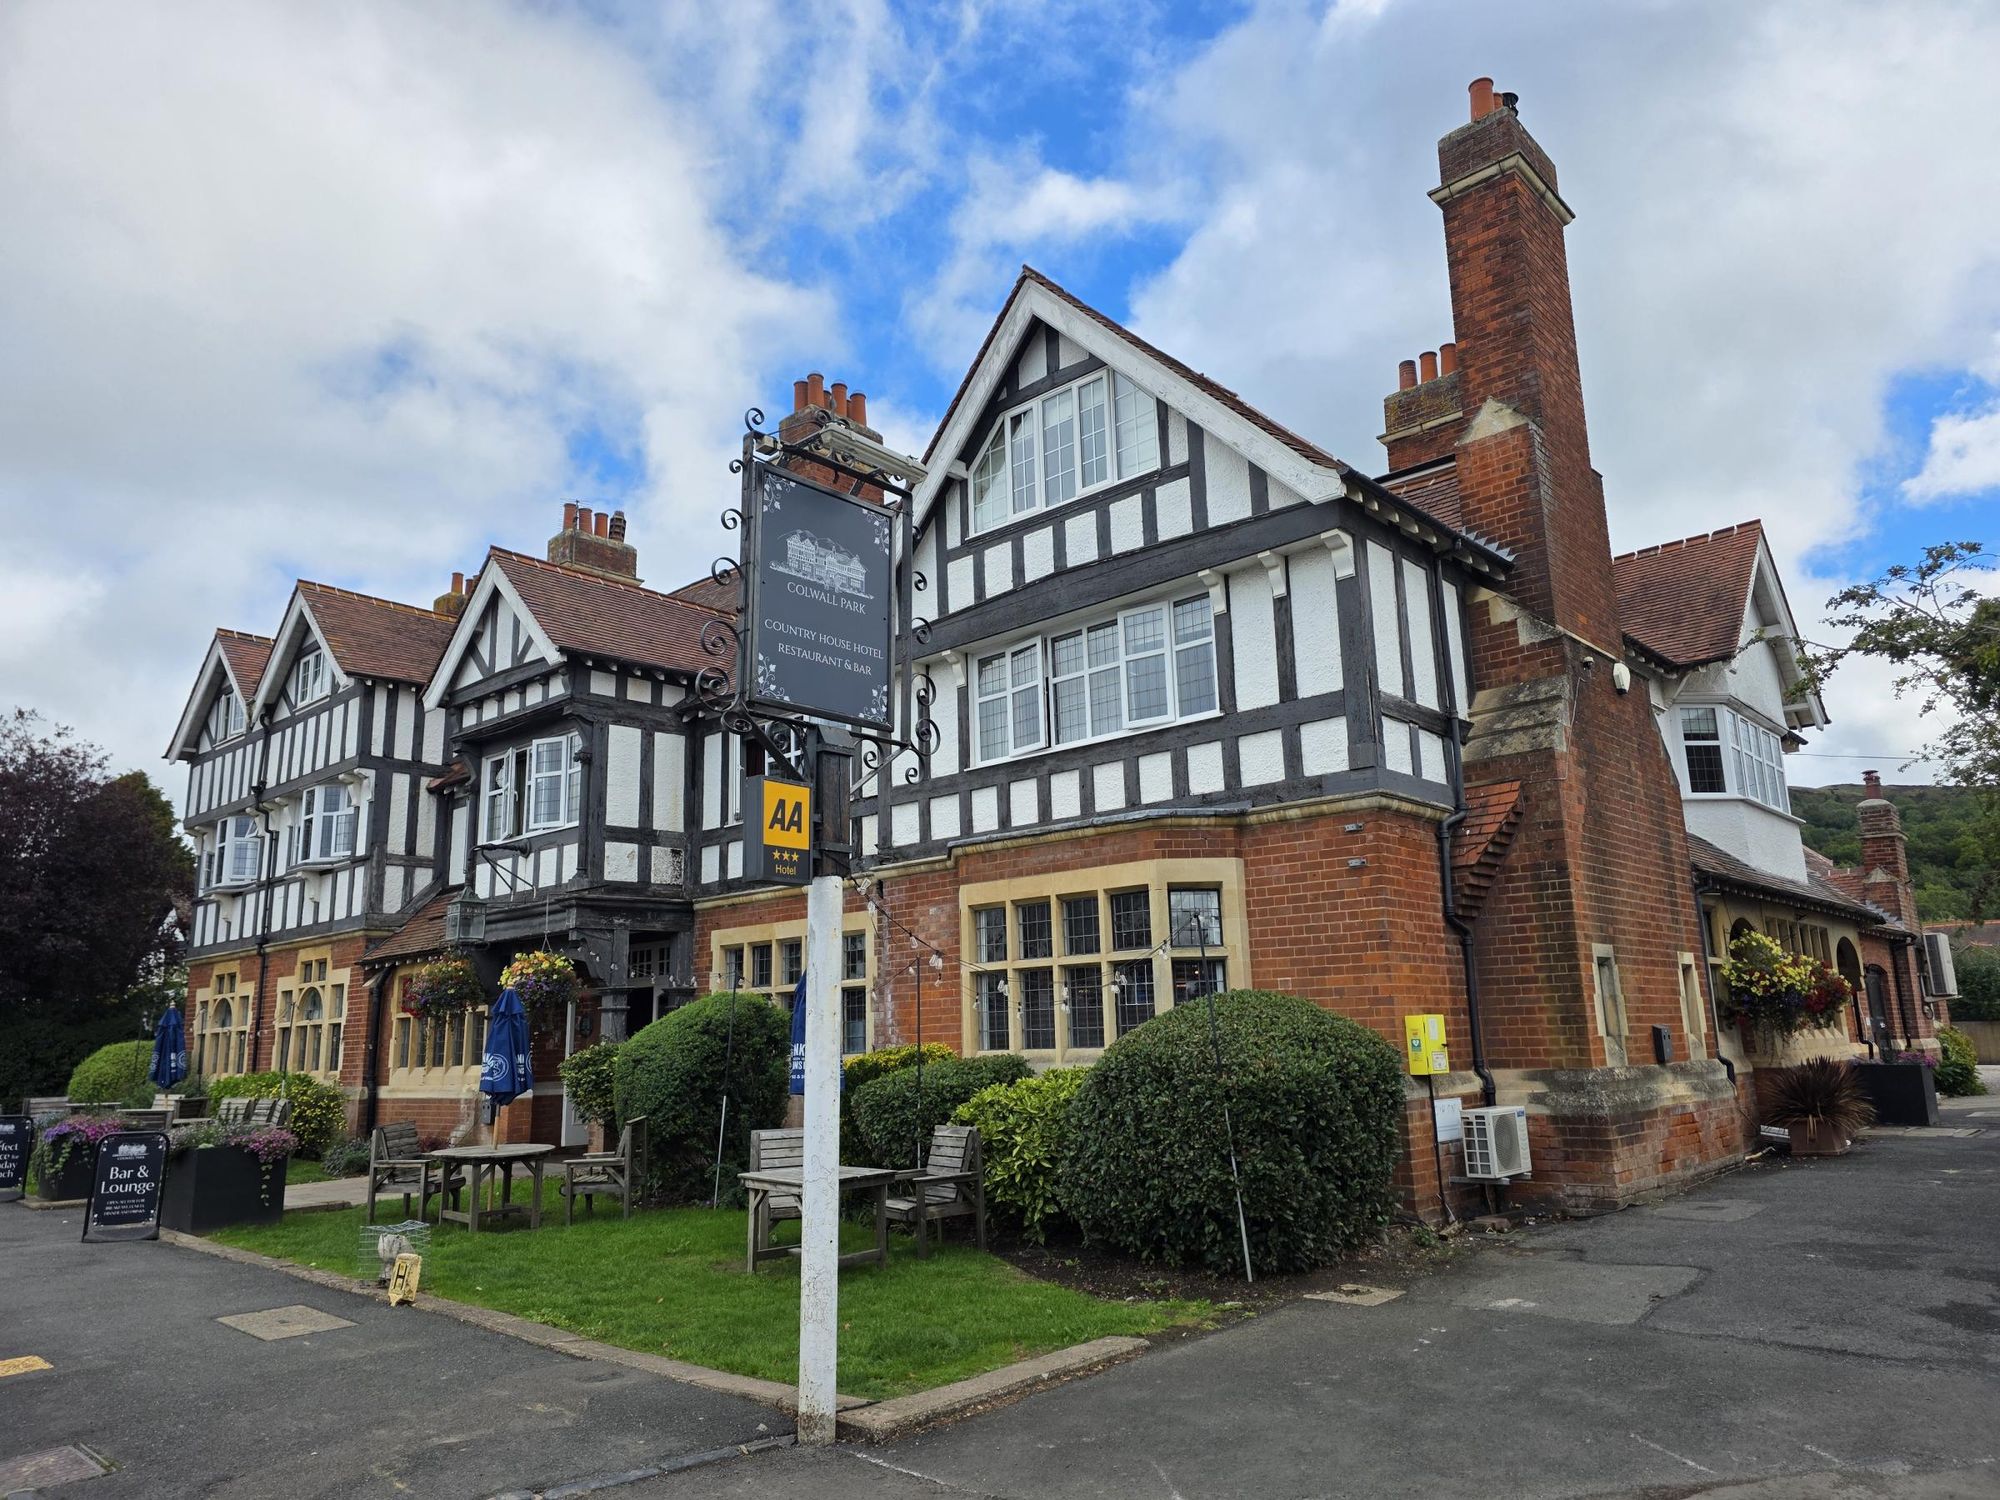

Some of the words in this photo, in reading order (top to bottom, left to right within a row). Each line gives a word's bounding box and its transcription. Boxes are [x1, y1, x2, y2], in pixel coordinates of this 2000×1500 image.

[787, 581, 838, 607] COLWALL
[840, 597, 866, 615] PARK
[764, 619, 817, 641] COUNTRY
[819, 633, 851, 651] HOUSE
[853, 643, 884, 659] HOTEL
[778, 643, 843, 668] RESTAURANT
[844, 658, 852, 670] &
[853, 661, 872, 676] BAR
[768, 798, 803, 833] AA
[775, 864, 797, 875] Hotel
[109, 1166, 134, 1180] Bar
[137, 1165, 149, 1178] &
[101, 1181, 155, 1195] Lounge
[393, 1263, 408, 1290] H
